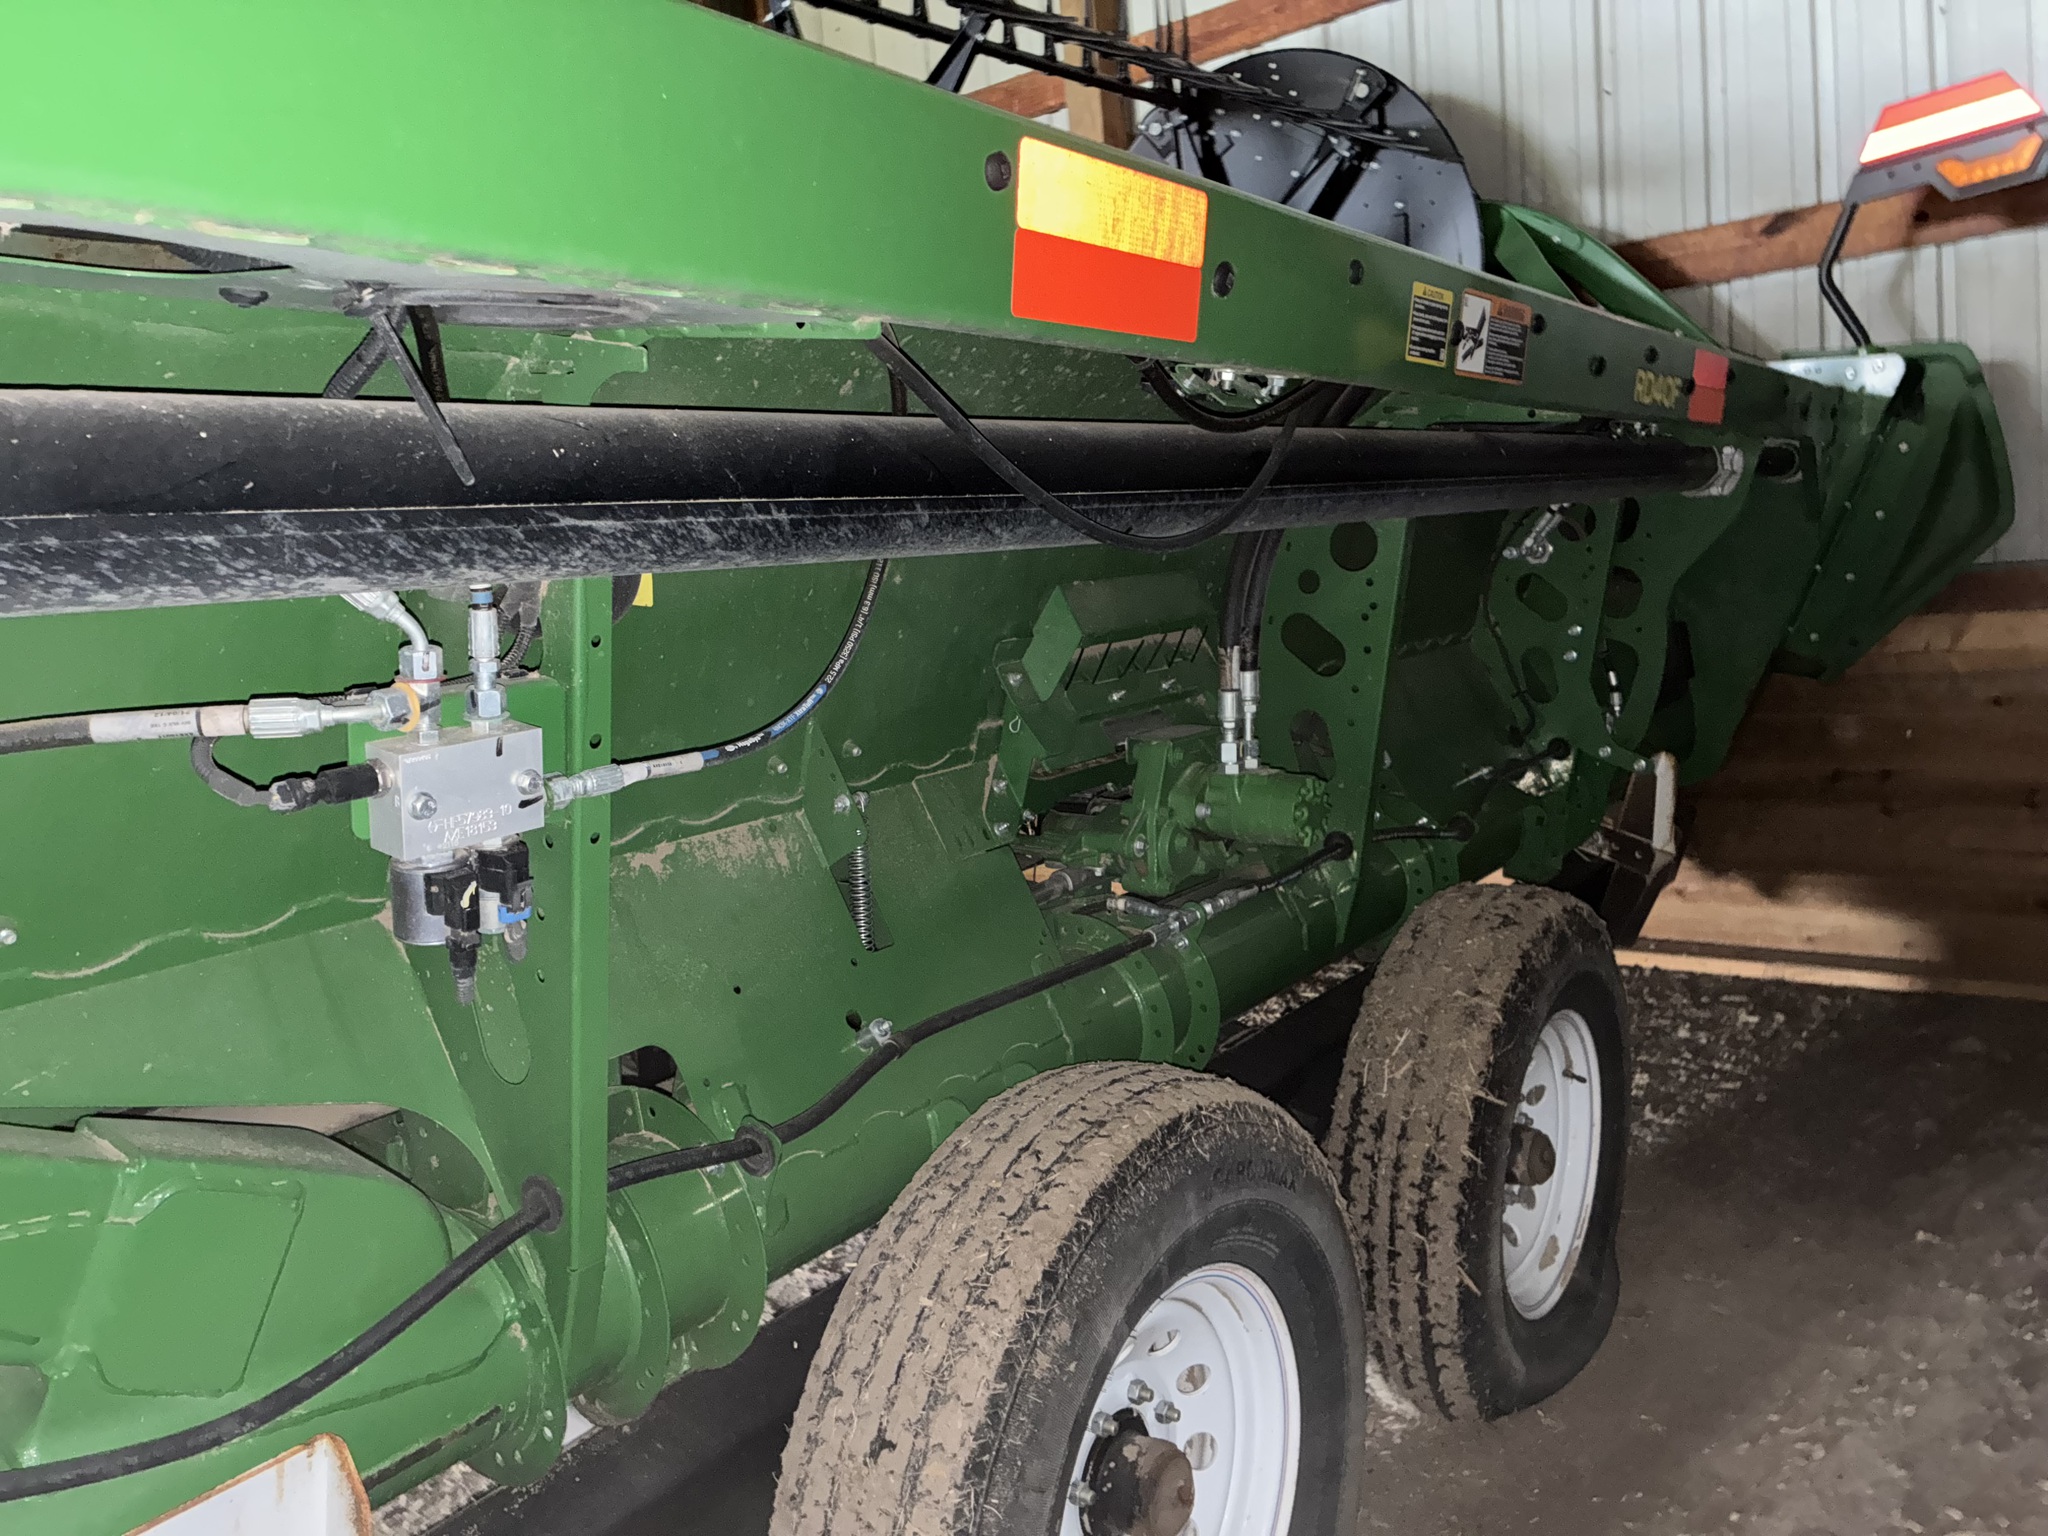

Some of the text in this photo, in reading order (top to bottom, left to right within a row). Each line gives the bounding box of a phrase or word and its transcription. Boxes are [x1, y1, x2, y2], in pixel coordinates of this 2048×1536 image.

[824, 670, 837, 684] 22.5
[833, 658, 845, 672] MPa
[872, 573, 880, 585] ISO
